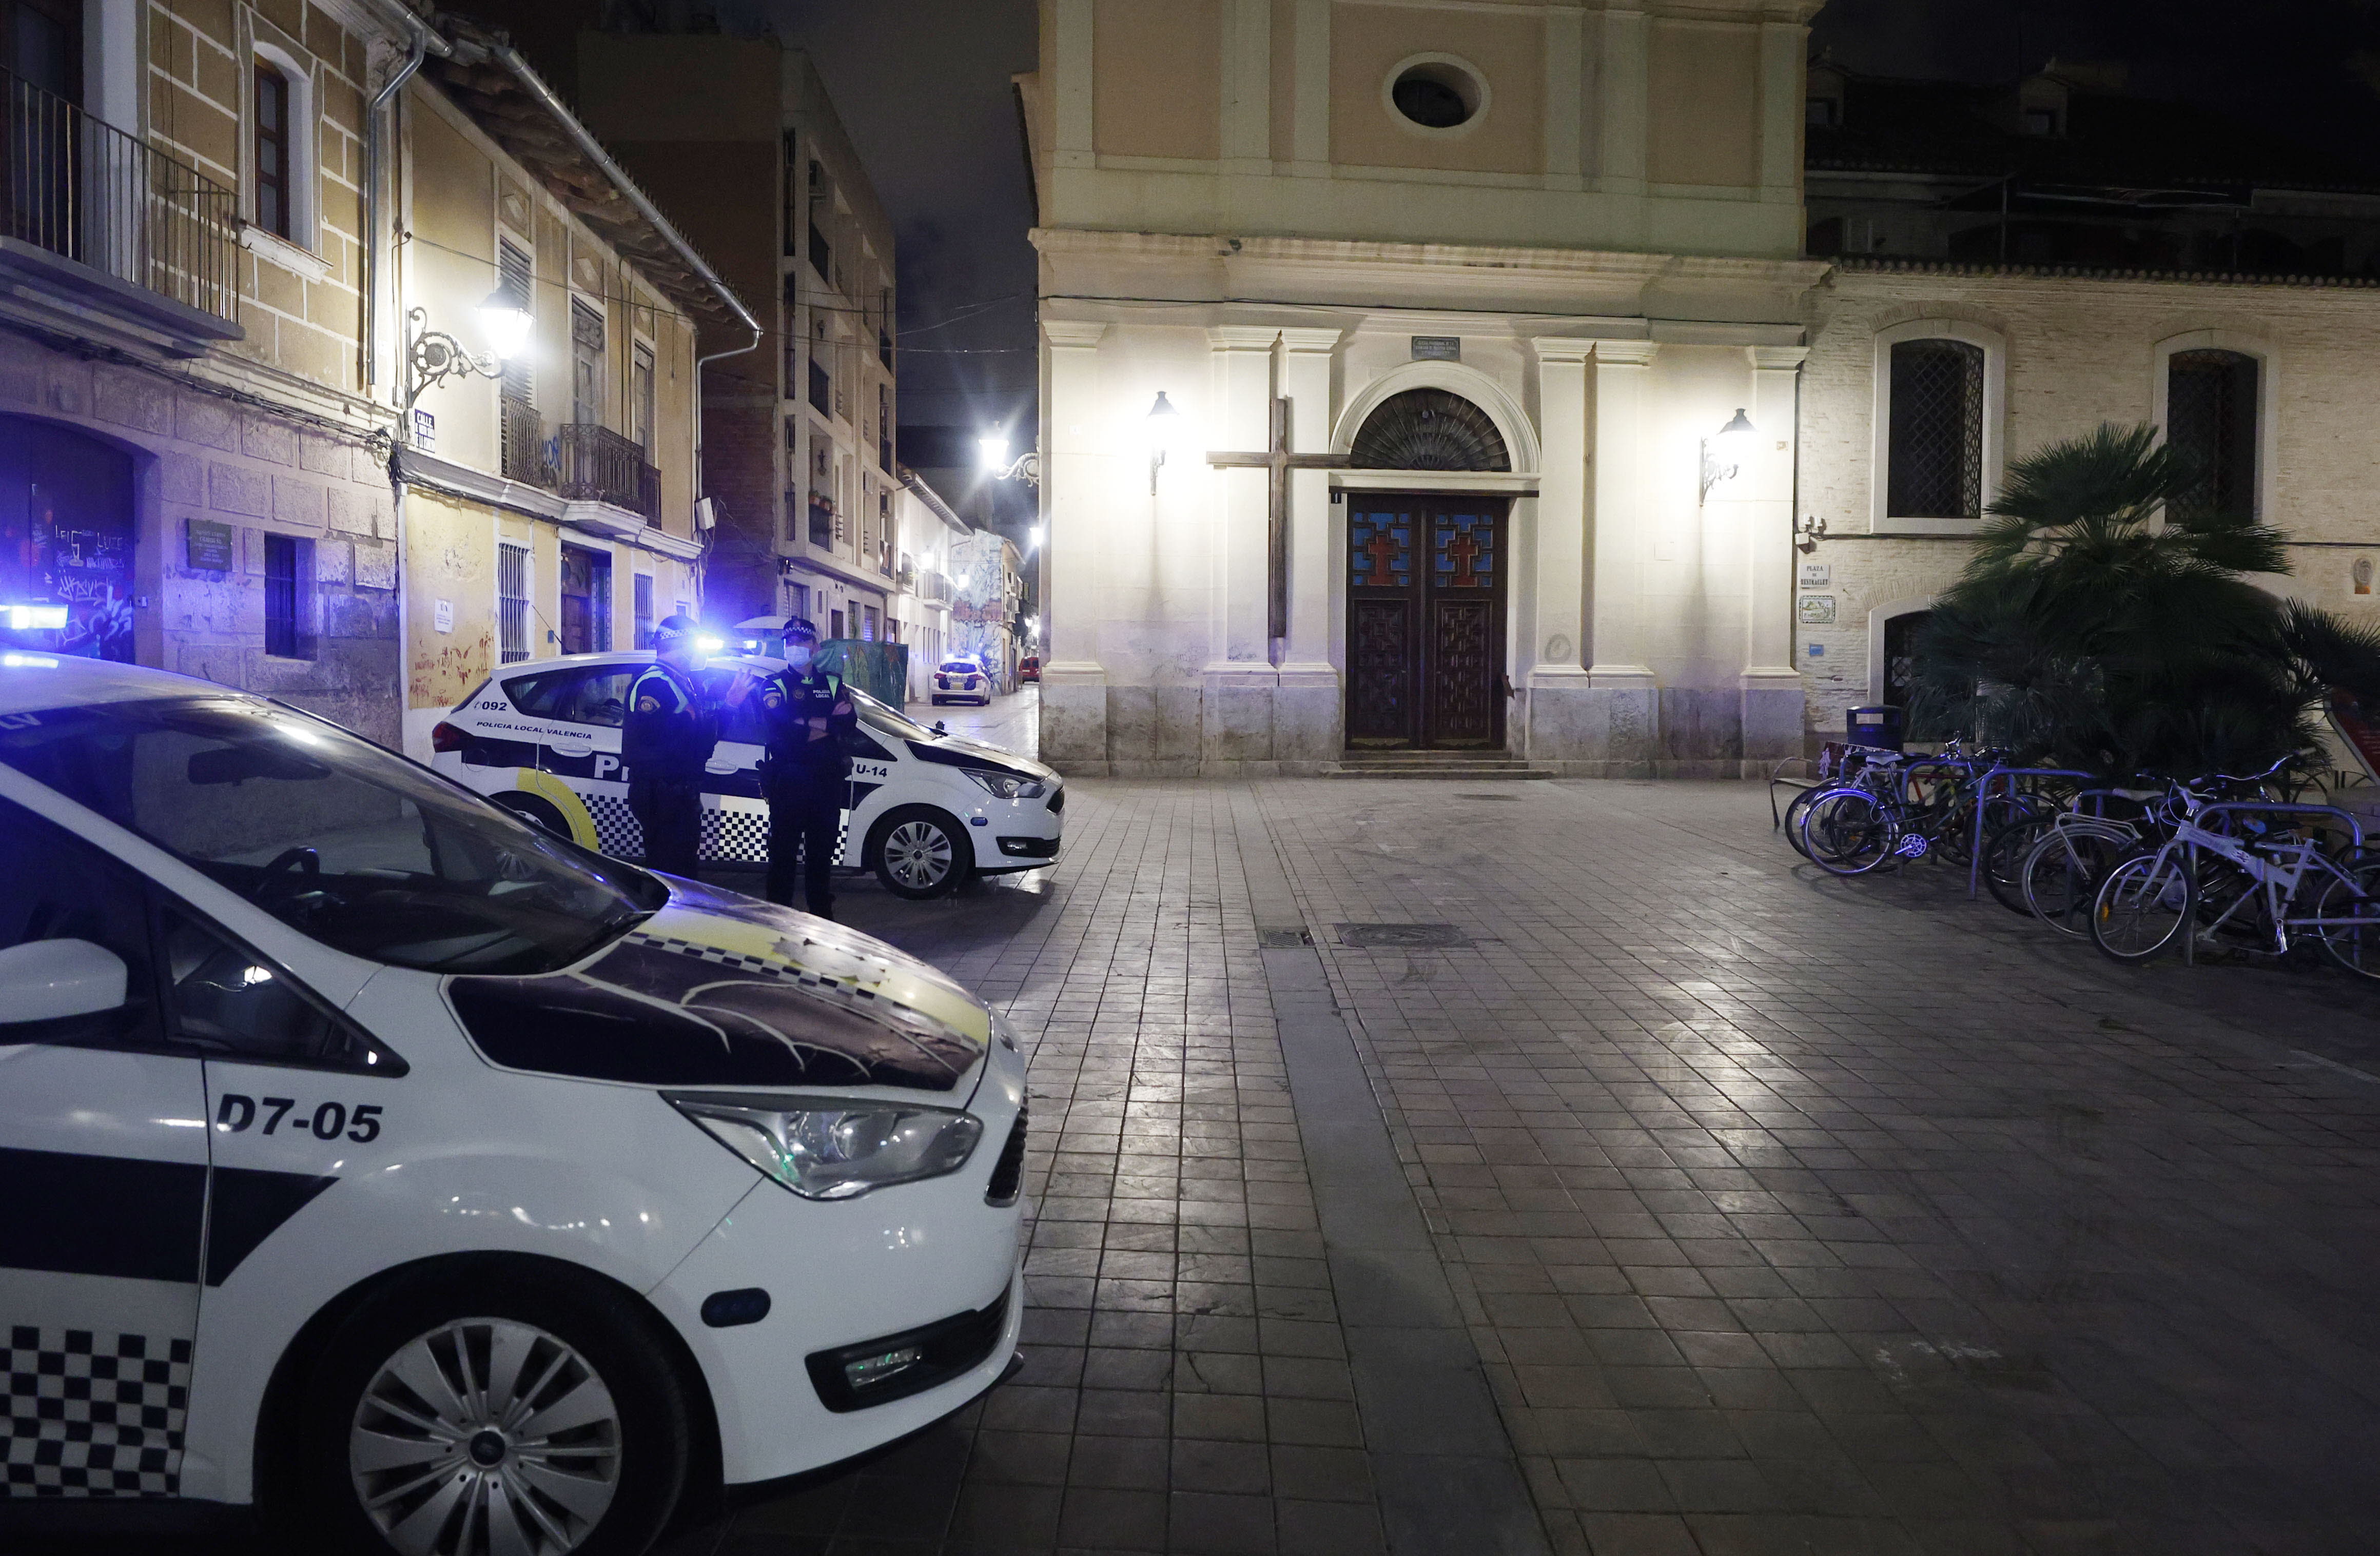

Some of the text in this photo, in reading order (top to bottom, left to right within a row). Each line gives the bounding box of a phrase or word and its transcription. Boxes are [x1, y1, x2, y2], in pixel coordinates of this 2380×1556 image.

[417, 412, 433, 428] CALLE
[482, 701, 507, 711] 092
[477, 721, 592, 739] POLICIA LOCAL VALENCIA
[856, 764, 887, 777] U-14
[217, 1093, 383, 1143] D7-05
